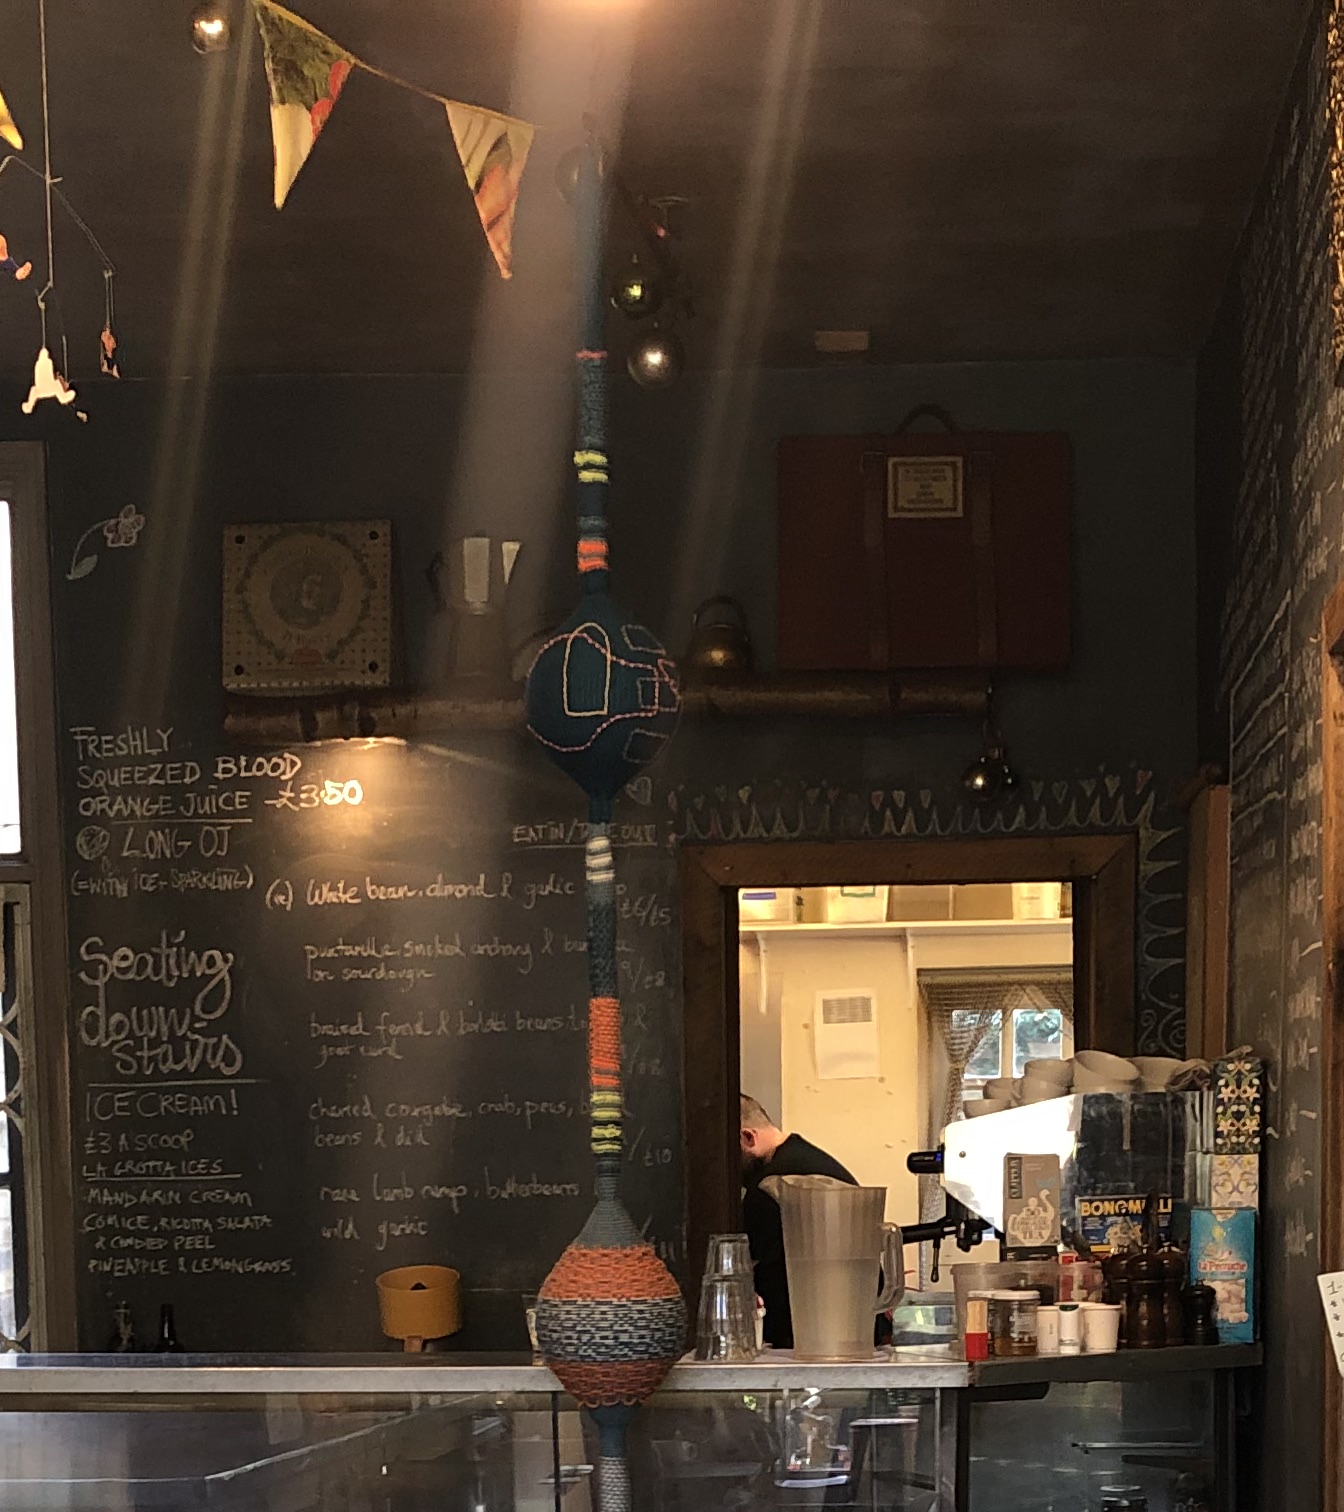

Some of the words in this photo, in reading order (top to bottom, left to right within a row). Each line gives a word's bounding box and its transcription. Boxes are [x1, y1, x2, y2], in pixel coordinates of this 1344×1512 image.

[70, 726, 174, 761] FRESHLY
[77, 762, 202, 794] SQUEEZED
[213, 752, 302, 781] BLOOD
[78, 793, 177, 819] ORANGE
[121, 826, 192, 859] LONG
[78, 928, 234, 1020] Seating
[86, 1090, 137, 1122] ICE
[137, 1088, 239, 1117] CREAM!
[134, 1129, 194, 1152] SCOOP
[181, 1159, 224, 1174] ICES
[188, 1189, 253, 1207] CREAM
[174, 1235, 216, 1249] PEEL
